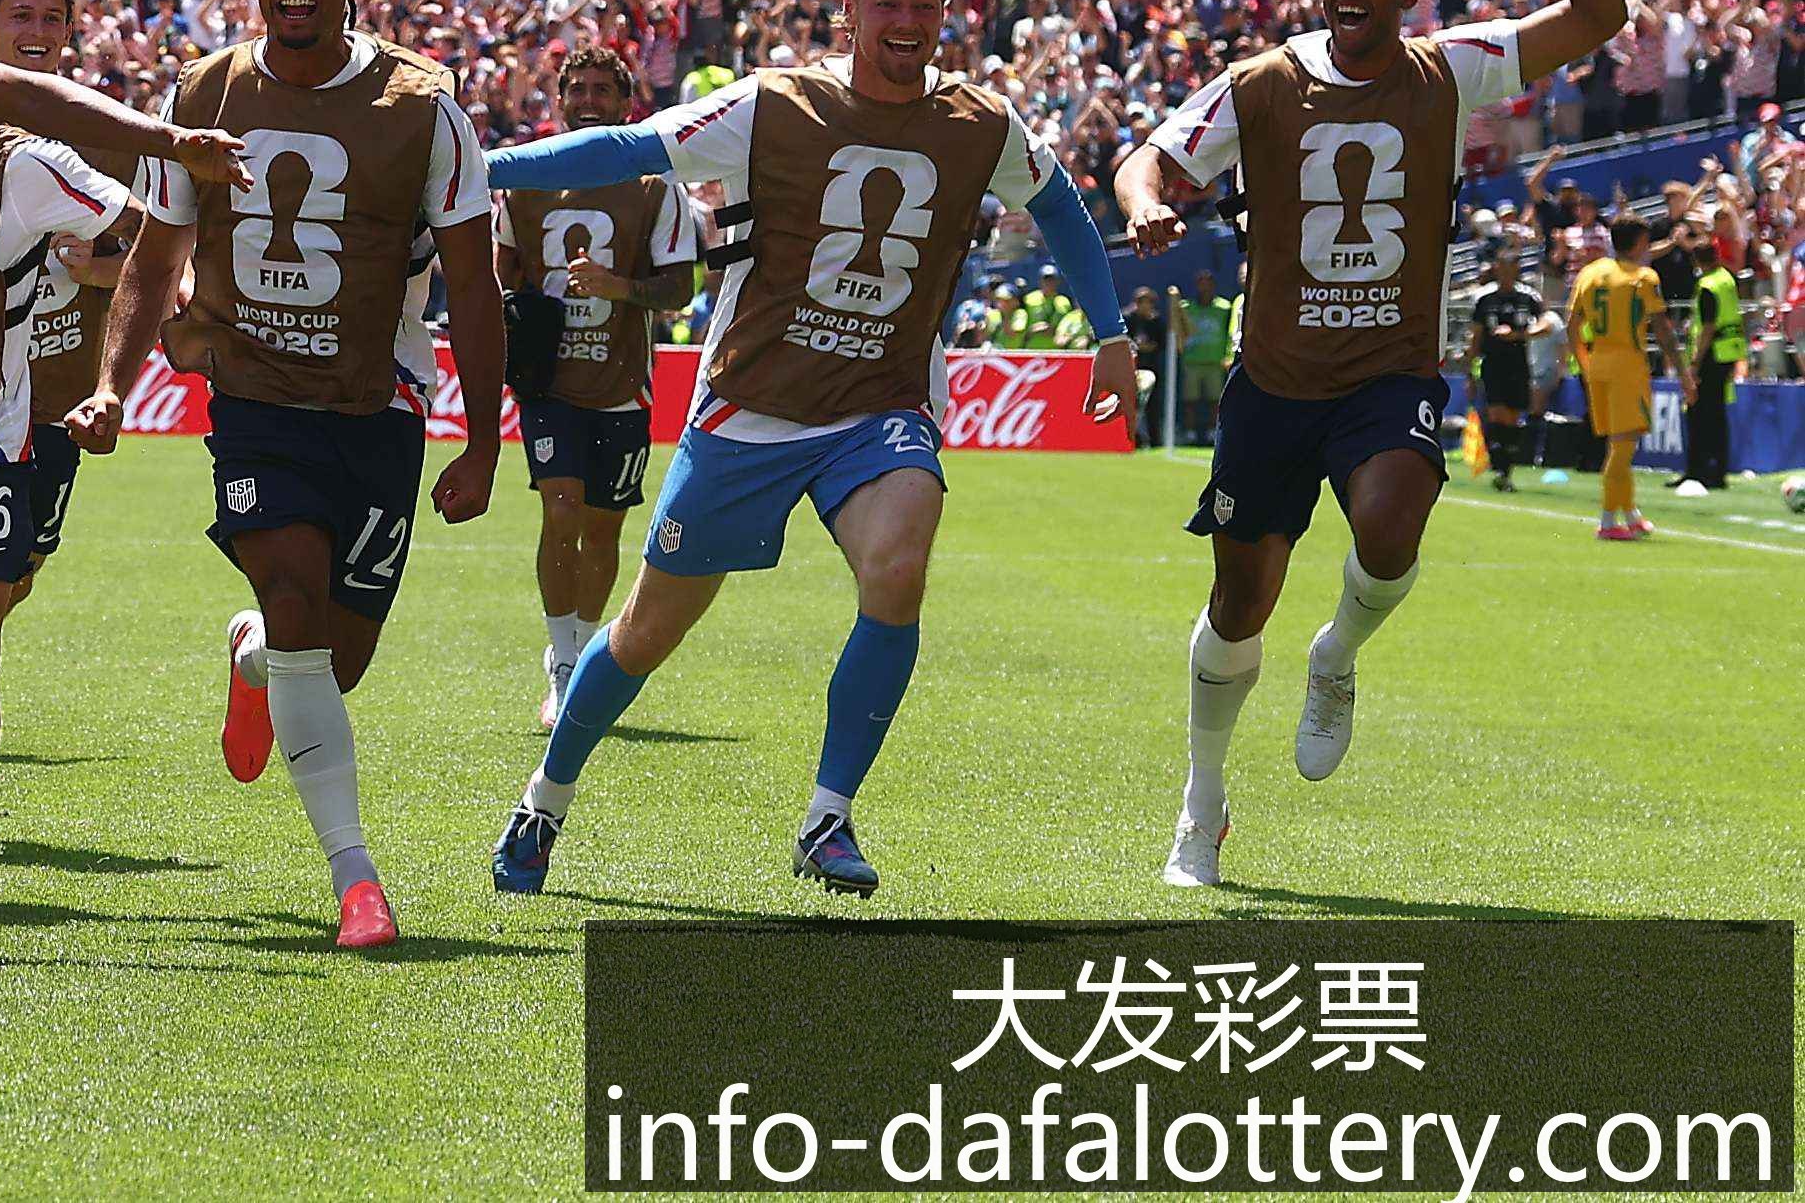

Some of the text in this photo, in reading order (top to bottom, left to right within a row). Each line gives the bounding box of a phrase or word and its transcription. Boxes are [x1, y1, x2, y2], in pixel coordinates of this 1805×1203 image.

[1331, 252, 1378, 268] FIFA
[259, 269, 310, 290] FIFA
[835, 278, 882, 302] FIFA
[1301, 287, 1401, 302] WORLD CUP
[53, 311, 81, 330] CUP
[236, 303, 340, 329] WORLD CUP
[795, 307, 895, 337] WORLD CUP
[1299, 304, 1401, 328] 2026
[1594, 288, 1608, 335] 5
[584, 331, 610, 342] CUP
[783, 324, 885, 360] 2026
[557, 343, 609, 362] 026
[1418, 400, 1436, 431] 6
[615, 447, 646, 490] 10
[229, 479, 253, 495] USA
[346, 507, 408, 578] 12
